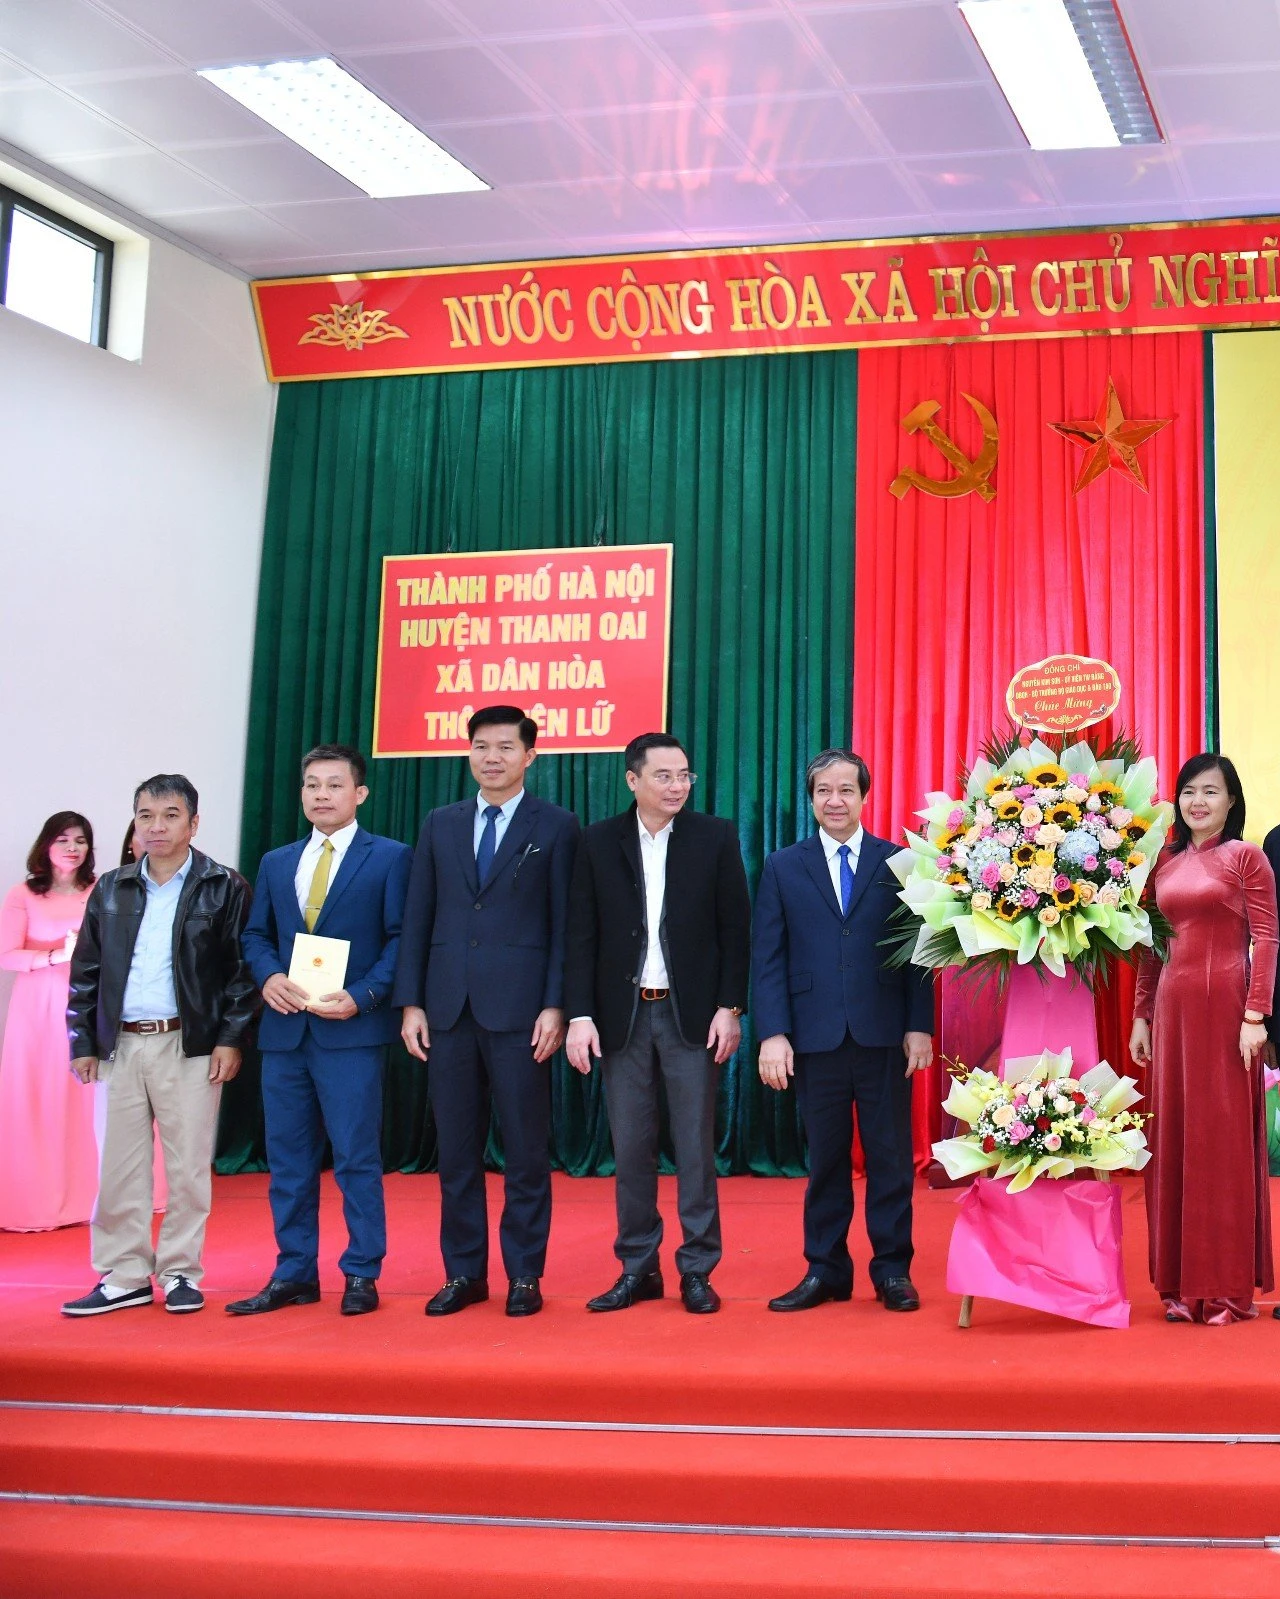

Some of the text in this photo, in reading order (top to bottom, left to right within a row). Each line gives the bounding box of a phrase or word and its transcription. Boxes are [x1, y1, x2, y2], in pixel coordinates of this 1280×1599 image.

[442, 270, 575, 349] NƯỚC
[586, 268, 715, 352] CỘNG
[725, 260, 831, 332] HÒA
[840, 256, 918, 326] XÃ
[929, 247, 1020, 333] HỘI
[1030, 233, 1132, 318] CHỦ
[396, 562, 656, 607] THÀNH PHỐ HÀ NỘI
[399, 610, 647, 652] HUYỆN THANH OAI
[435, 654, 605, 693] XÃ DÂN HÒA
[424, 699, 615, 741] THÔ ÊN LỮ
